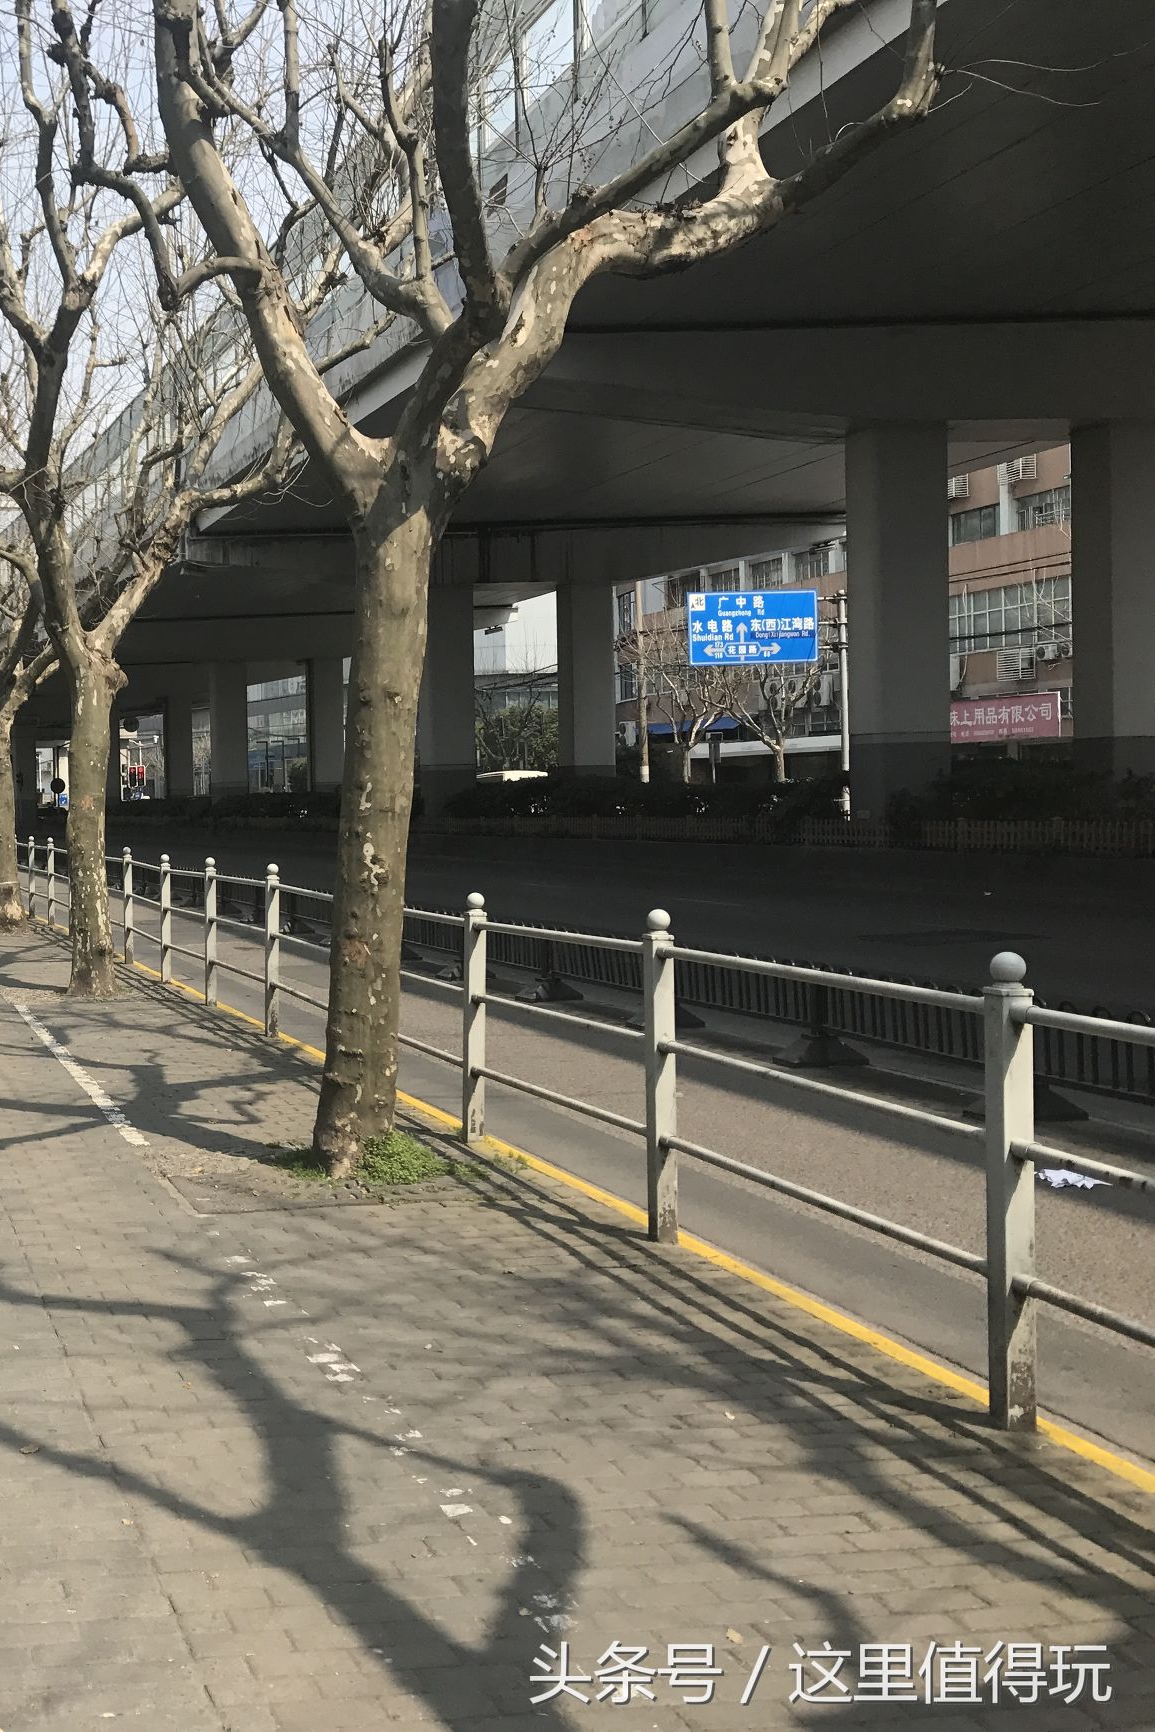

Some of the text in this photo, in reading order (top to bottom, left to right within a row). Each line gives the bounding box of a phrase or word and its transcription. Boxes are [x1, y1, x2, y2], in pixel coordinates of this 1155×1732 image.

[695, 597, 704, 606] 北
[717, 596, 764, 609] 广中路
[692, 619, 733, 633] 水电路
[750, 617, 814, 632] 东(西)江湾路
[692, 632, 734, 642] Shuidian Rd
[727, 645, 757, 654] 花园路
